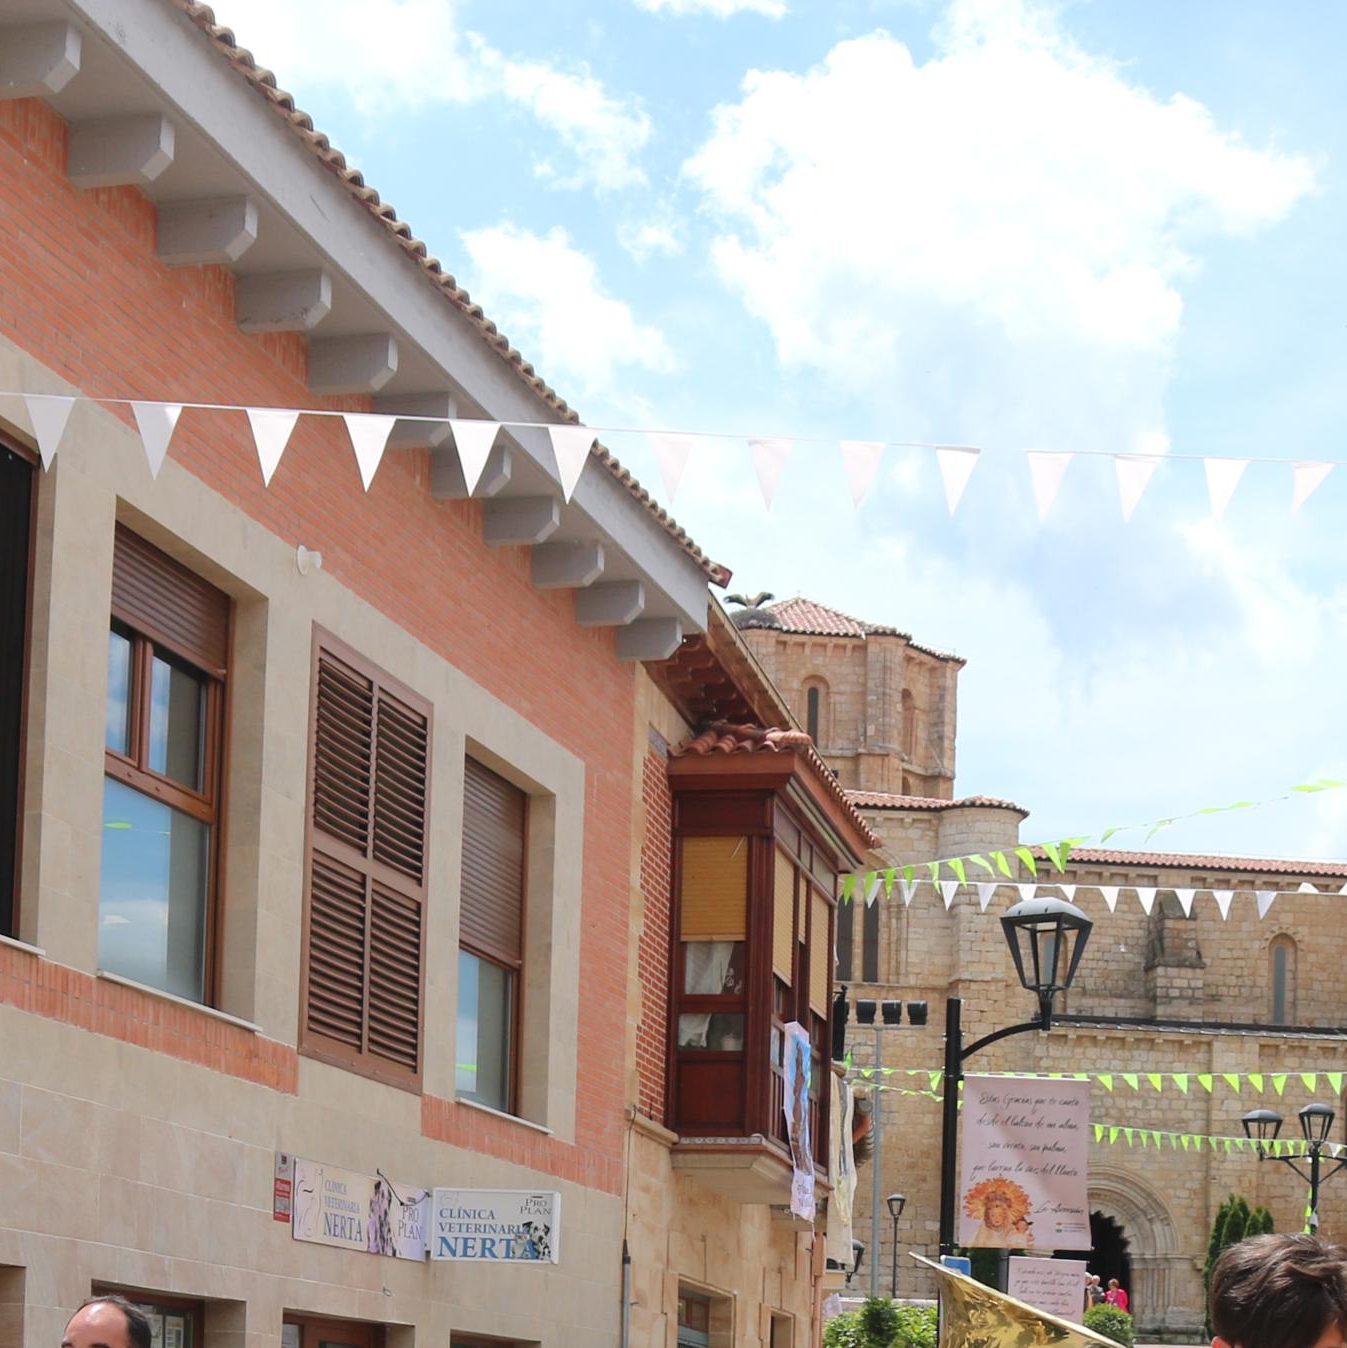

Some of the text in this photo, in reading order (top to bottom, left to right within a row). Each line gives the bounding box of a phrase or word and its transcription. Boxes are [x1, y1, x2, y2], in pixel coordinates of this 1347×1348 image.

[520, 1206, 552, 1215] PLAN
[525, 1198, 547, 1207] PRO
[403, 1206, 419, 1222] PRO
[439, 1206, 496, 1220] CLÍNICA
[324, 1212, 363, 1242] NERTA
[398, 1220, 422, 1240] PLAN
[438, 1236, 540, 1260] NERTA
